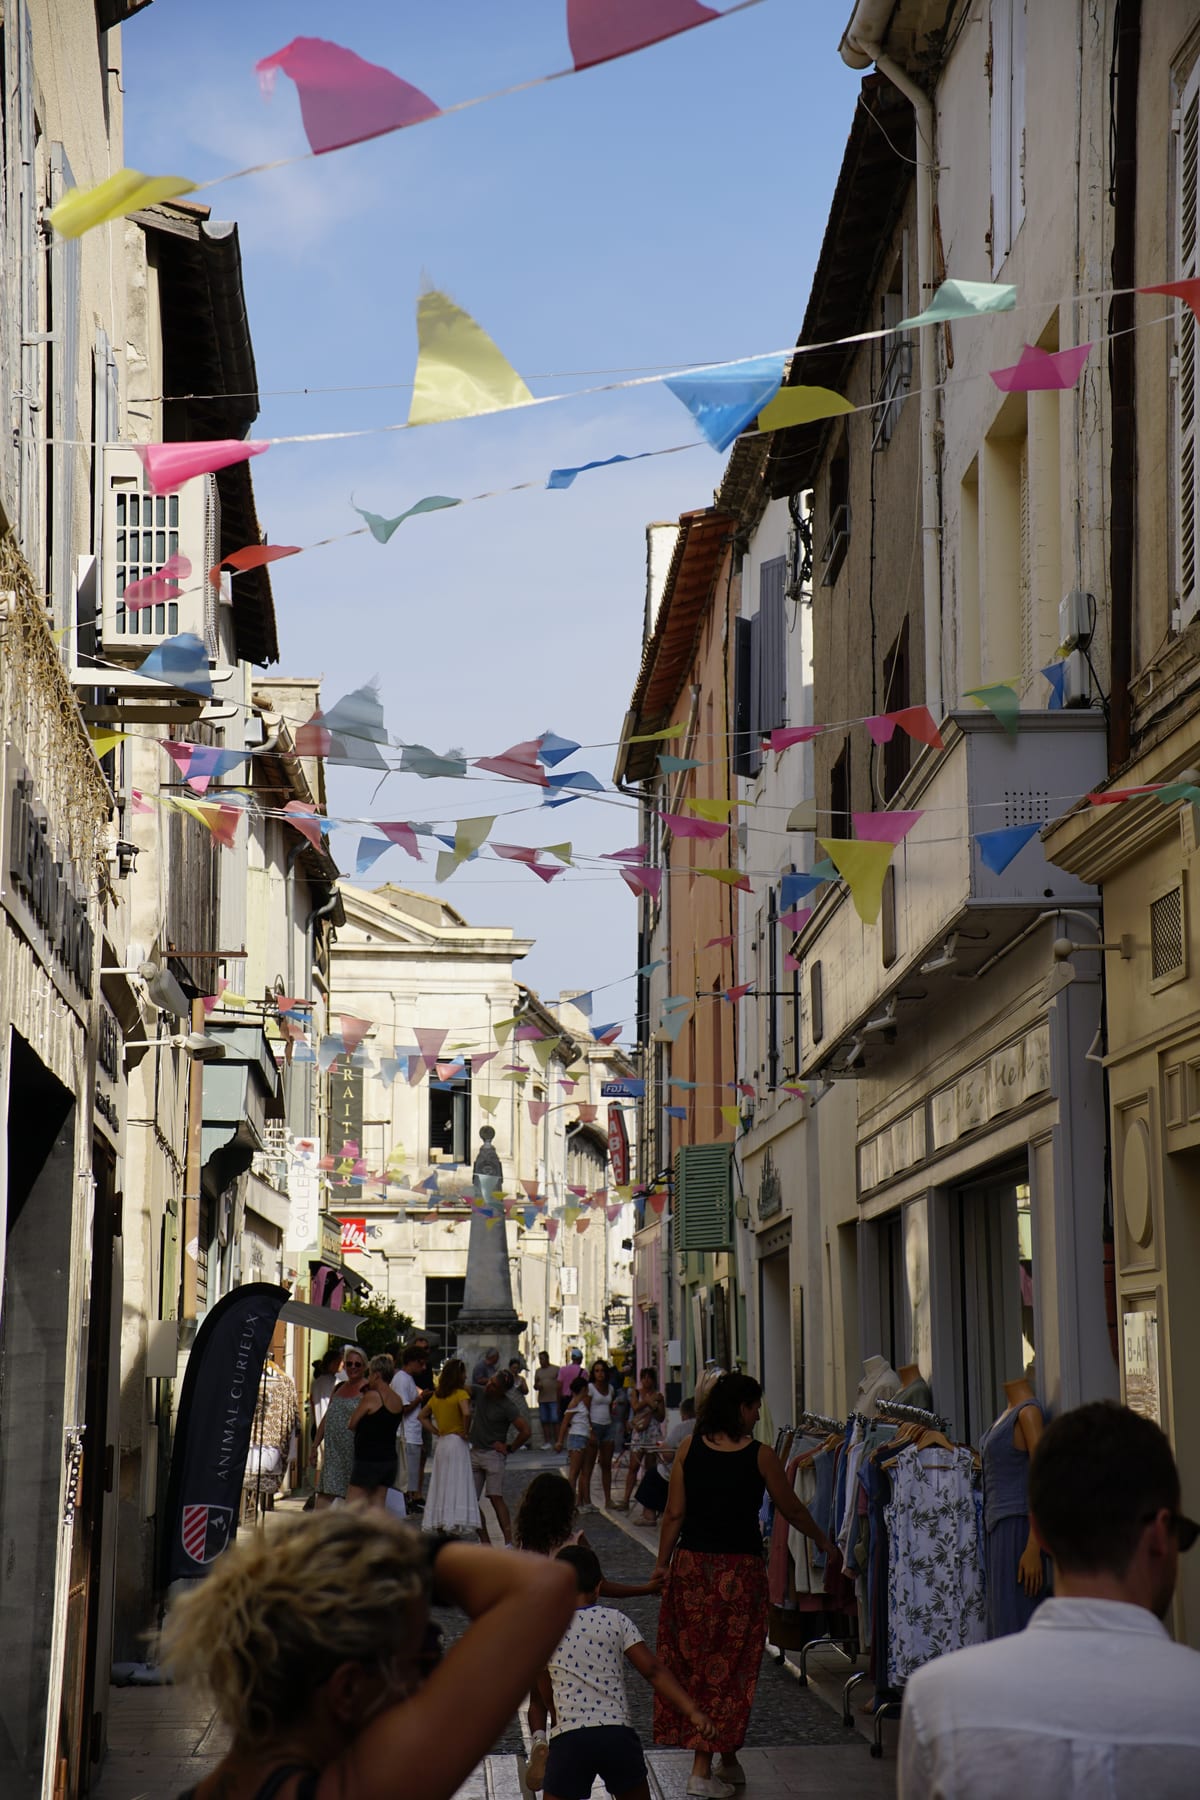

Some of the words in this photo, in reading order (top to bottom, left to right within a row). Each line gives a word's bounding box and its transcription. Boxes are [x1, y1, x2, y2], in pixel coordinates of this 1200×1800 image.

[343, 1052, 354, 1188] TRAITR
[608, 1105, 623, 1183] TABAC
[296, 1156, 310, 1238] GALLER
[341, 1223, 365, 1248] lly
[217, 1404, 241, 1480] ANIMAL
[231, 1313, 260, 1399] CURIEUX
